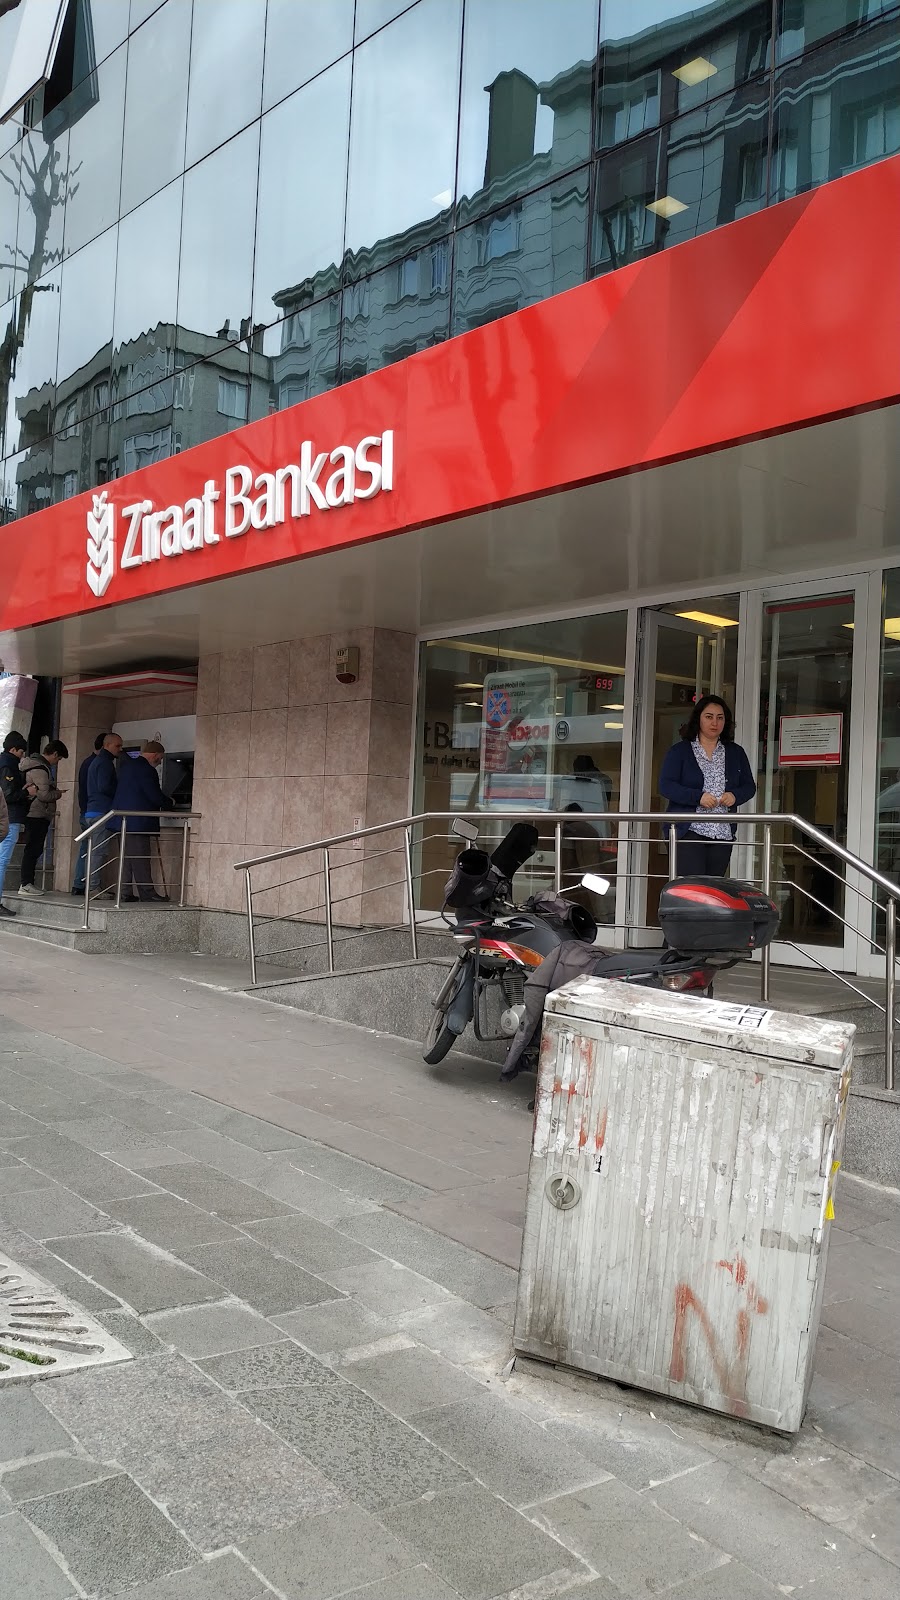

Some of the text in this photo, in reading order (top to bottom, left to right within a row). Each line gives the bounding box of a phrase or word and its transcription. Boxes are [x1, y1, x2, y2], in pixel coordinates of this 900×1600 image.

[120, 429, 395, 570] Ziraat Bankası
[595, 677, 613, 690] 699
